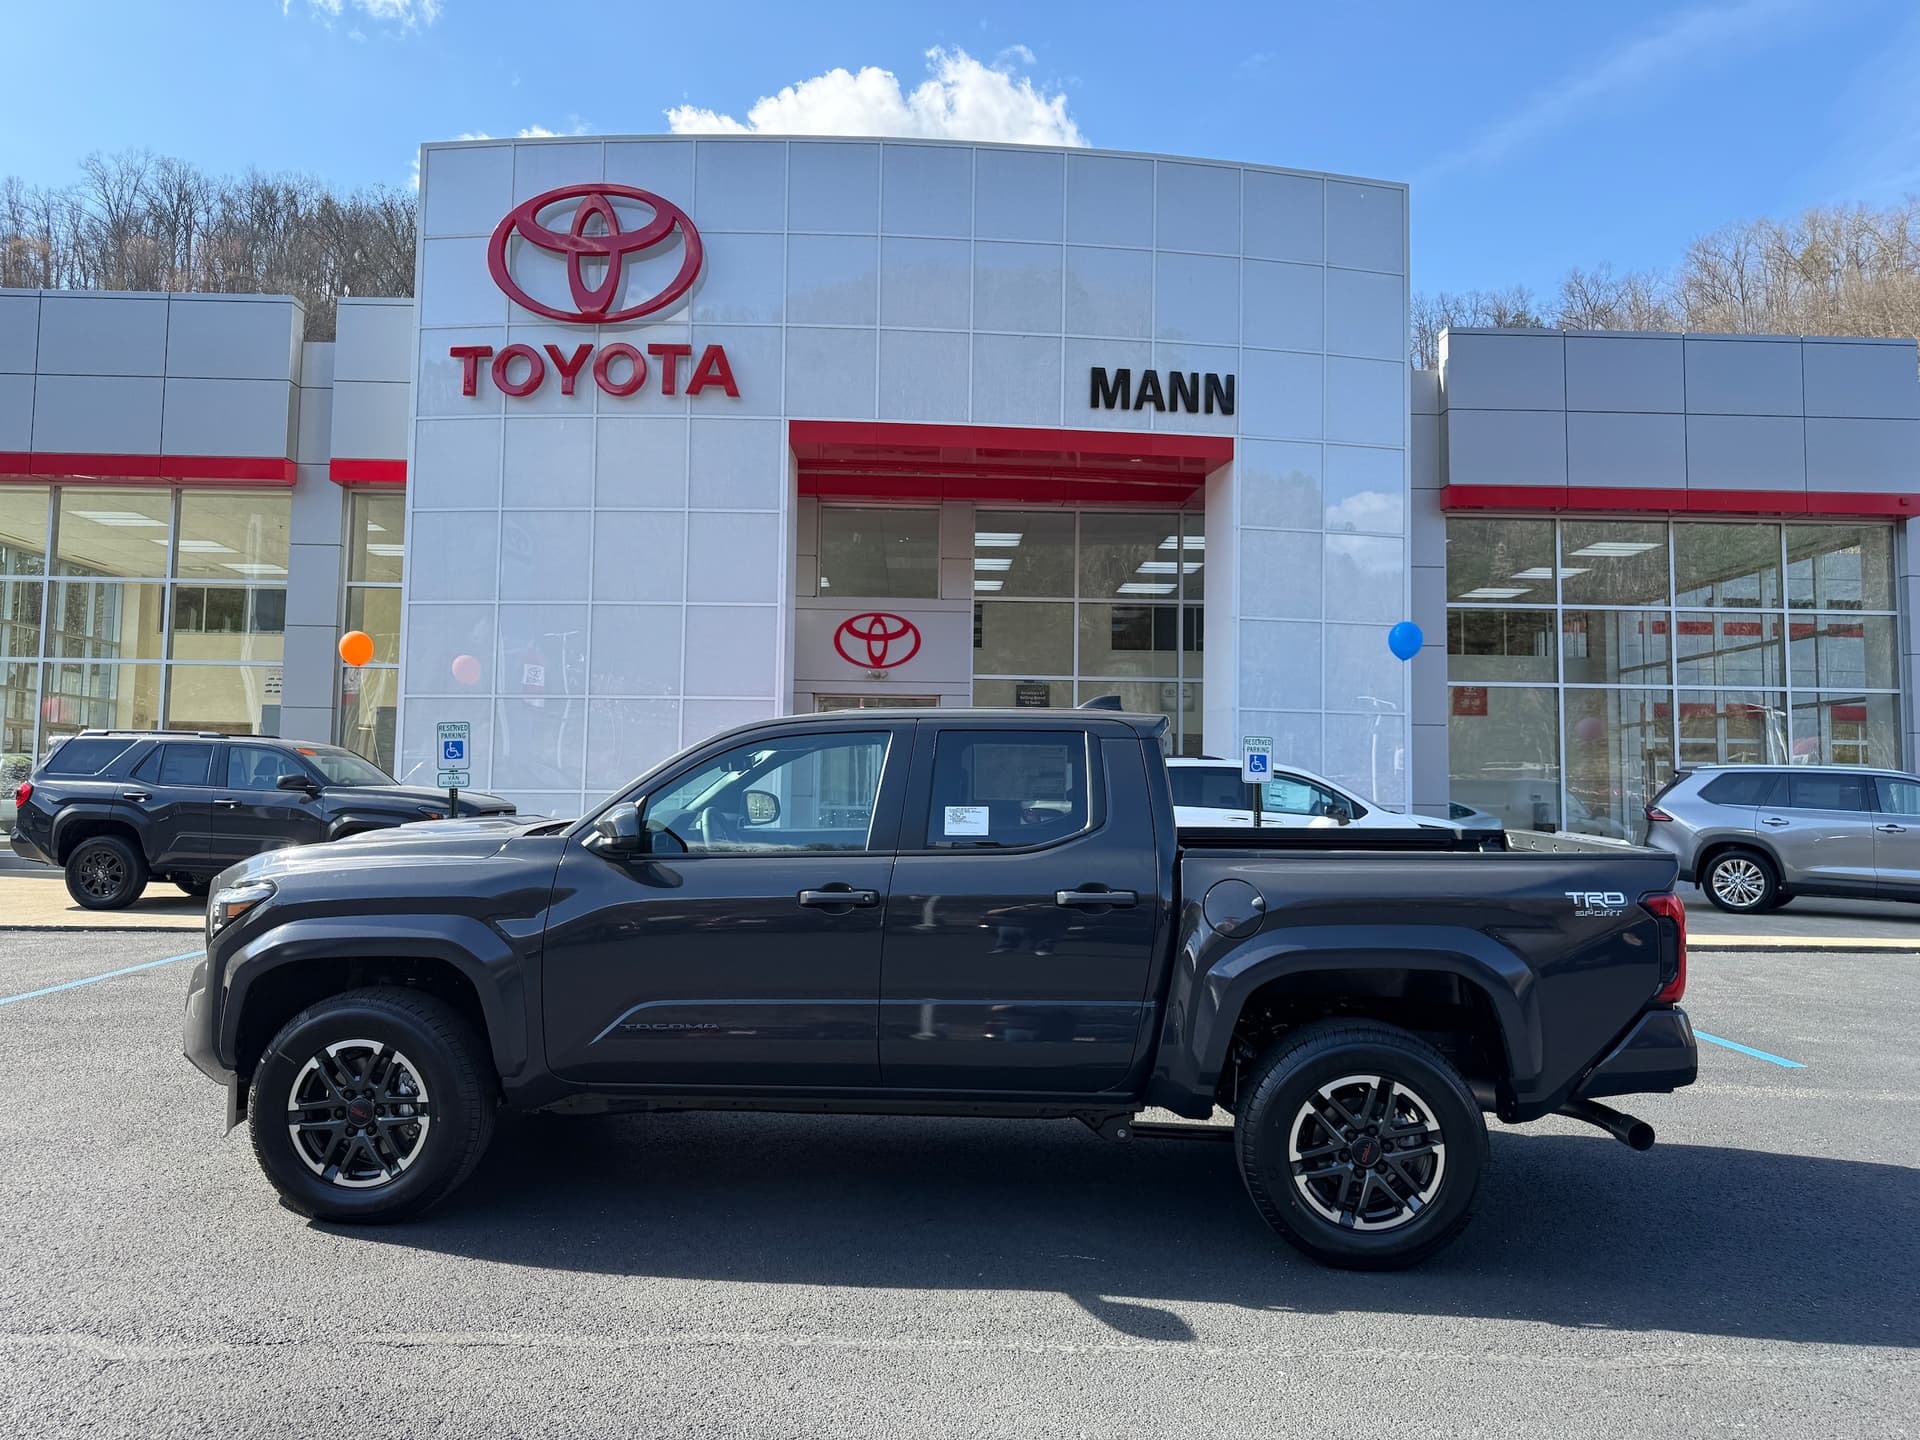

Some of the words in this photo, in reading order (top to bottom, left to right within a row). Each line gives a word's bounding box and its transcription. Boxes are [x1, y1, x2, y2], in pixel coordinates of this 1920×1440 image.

[450, 343, 740, 398] TOYOTA
[1090, 367, 1235, 415] MANN
[1244, 738, 1271, 746] RESERVED
[1564, 891, 1625, 908] TRD
[1575, 909, 1623, 917] SPORT
[620, 1023, 720, 1031] TACOMA
